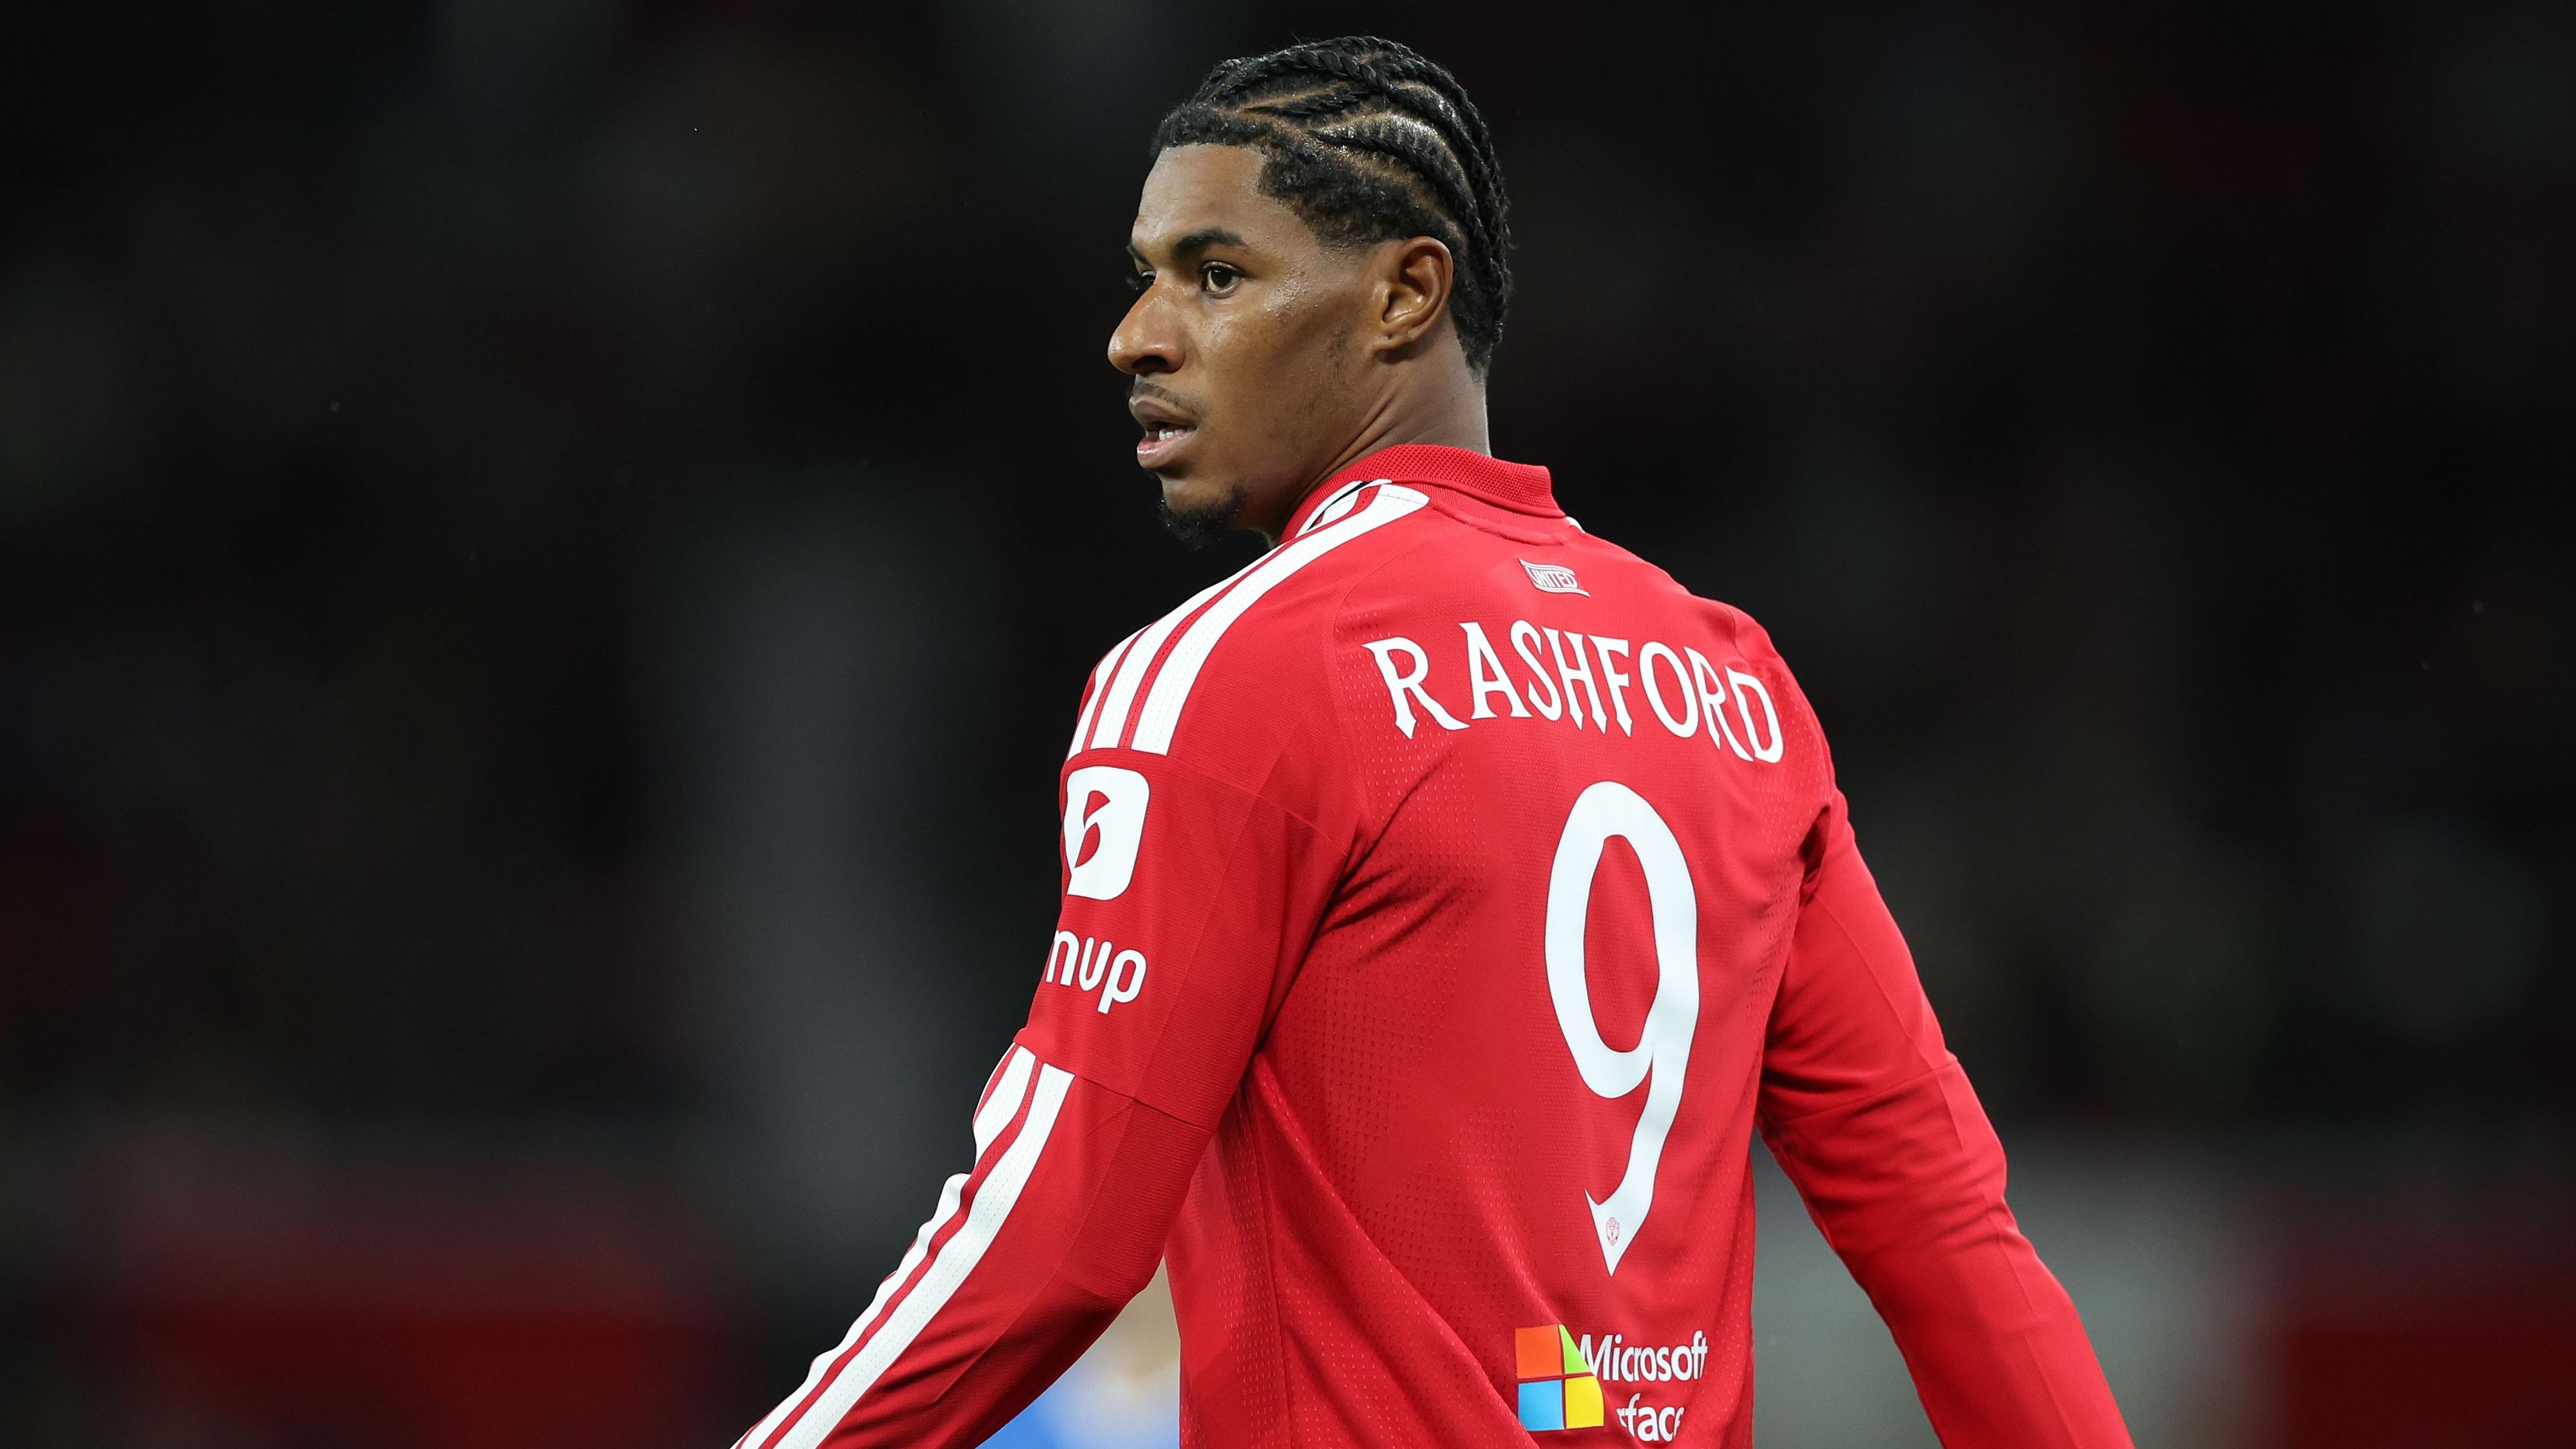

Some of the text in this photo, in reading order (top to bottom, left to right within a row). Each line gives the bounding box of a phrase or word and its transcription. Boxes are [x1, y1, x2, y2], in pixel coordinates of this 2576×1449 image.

[1361, 620, 1784, 764] RASHFORD
[1544, 781, 1700, 1277] 9
[1579, 1330, 1708, 1382] Microsoft
